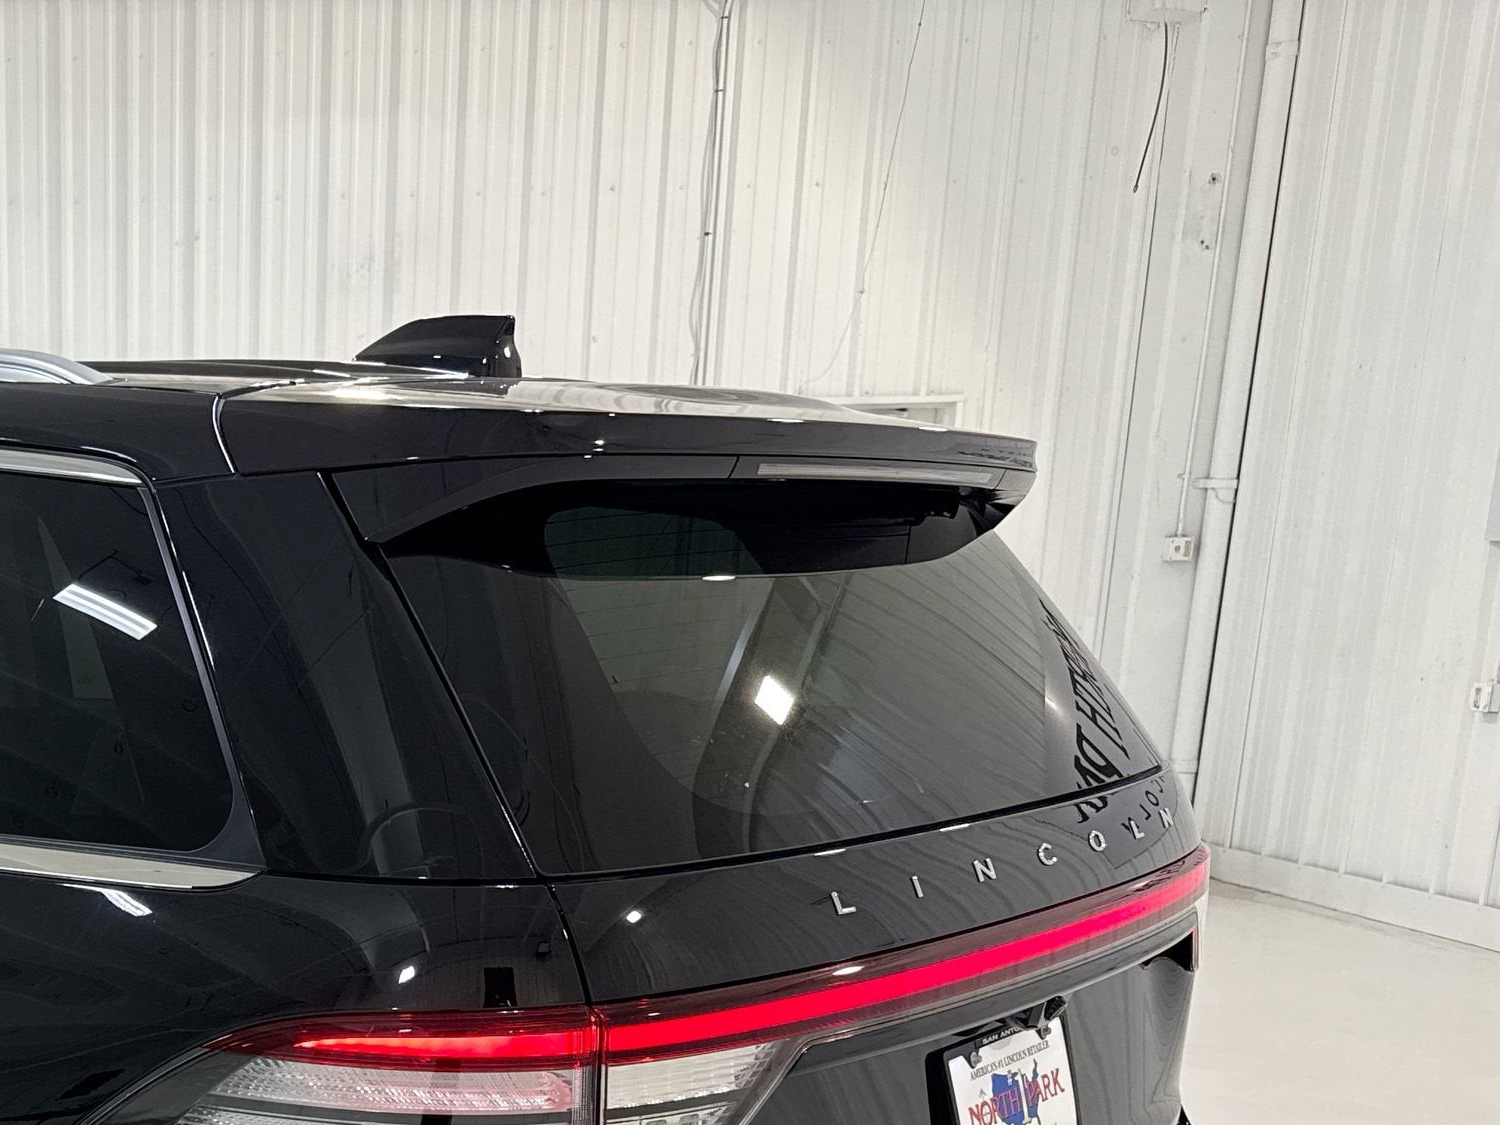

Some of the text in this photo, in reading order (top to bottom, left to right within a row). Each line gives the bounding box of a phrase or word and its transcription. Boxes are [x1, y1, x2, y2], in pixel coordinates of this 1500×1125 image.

[830, 807, 1174, 916] LINCOLN
[982, 1033, 999, 1045] SAN
[1004, 1049, 1028, 1069] LINCOLN
[1027, 1040, 1050, 1057] RETAILER
[1025, 1067, 1066, 1107] PARK
